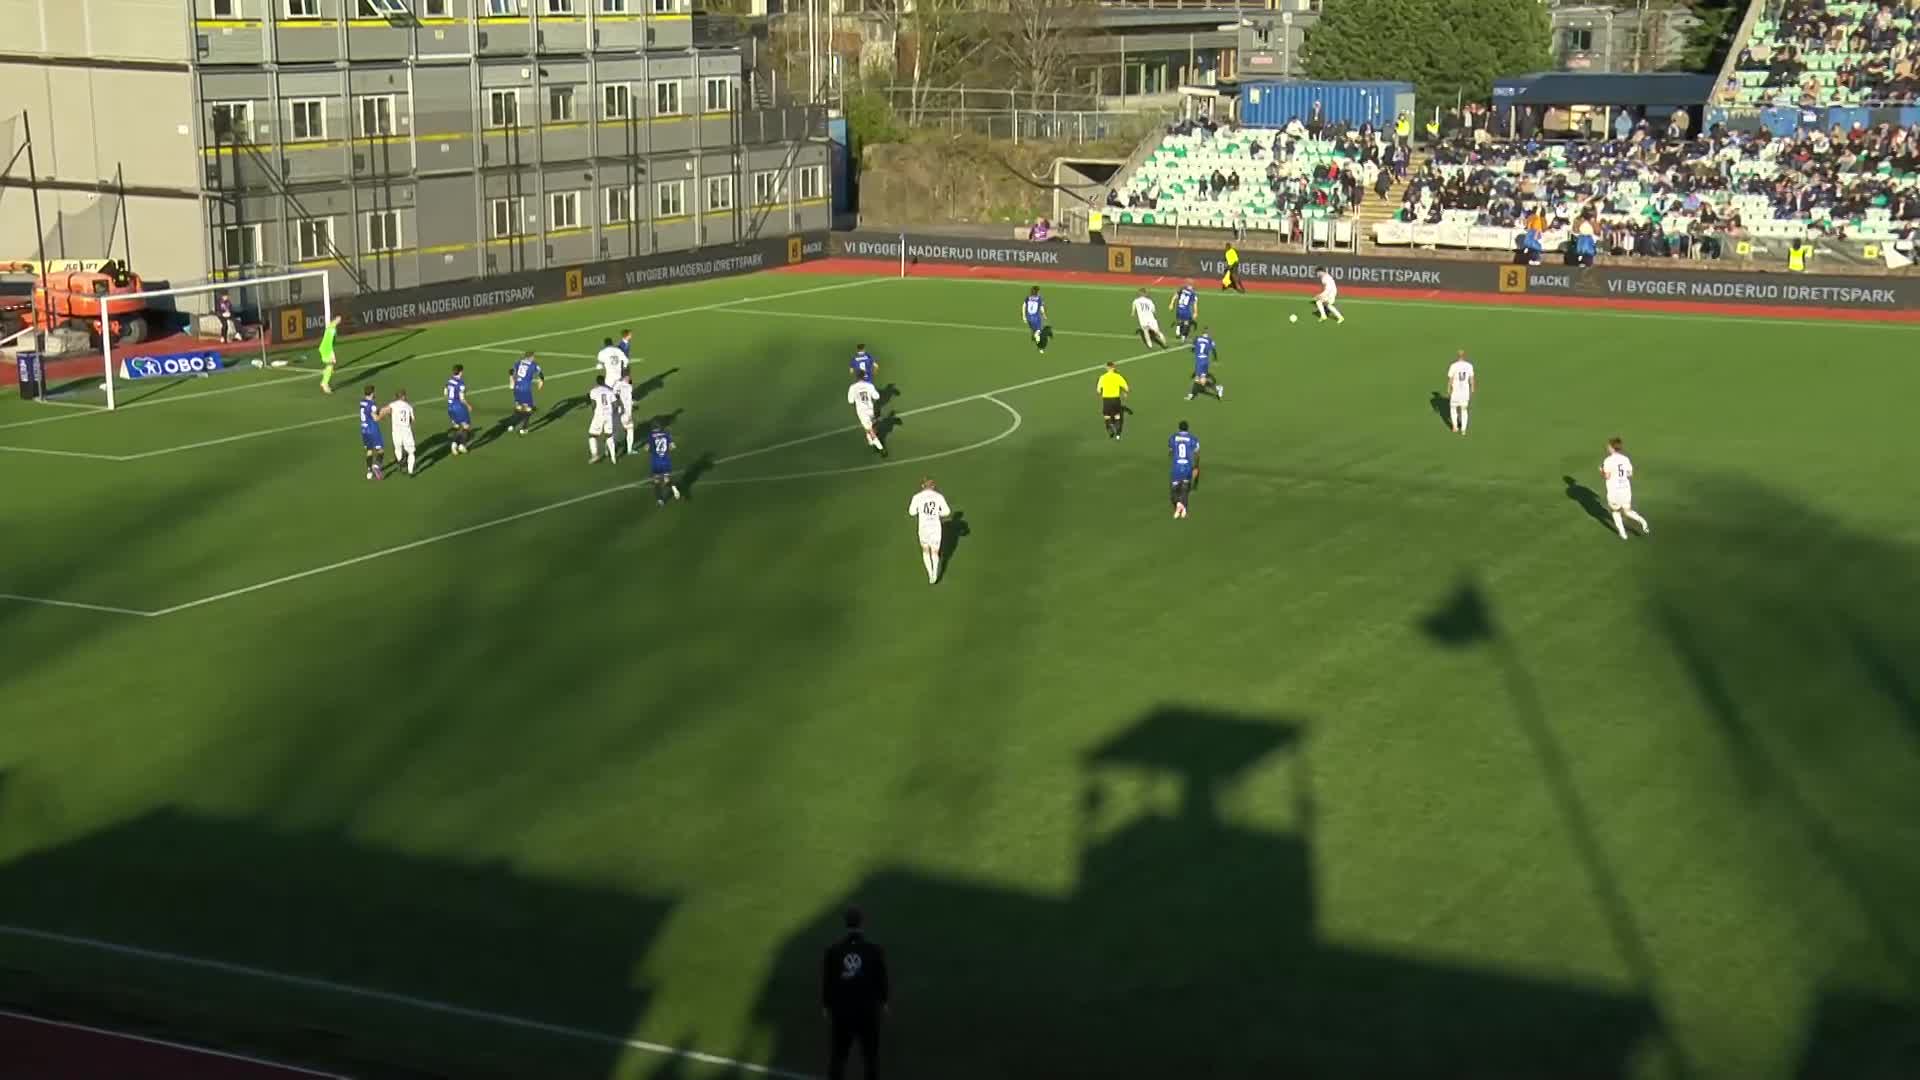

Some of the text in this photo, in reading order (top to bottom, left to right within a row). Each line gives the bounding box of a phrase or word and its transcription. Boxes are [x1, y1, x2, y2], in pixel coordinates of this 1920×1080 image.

[844, 241, 856, 253] VI
[908, 245, 974, 260] NADDERUD
[977, 247, 1059, 264] IDRETTSPARK
[1134, 255, 1169, 268] BACKE
[1200, 261, 1213, 273] VI
[1217, 261, 1267, 275] BGER
[1348, 264, 1441, 284] IDRETTSPARK
[1529, 274, 1570, 288] BACKE
[1607, 279, 1896, 303] VI BYGGER NADDERUD IDRETTSPARK
[363, 285, 535, 324] VI BYGGER NADDERUD IDRETTSPARK
